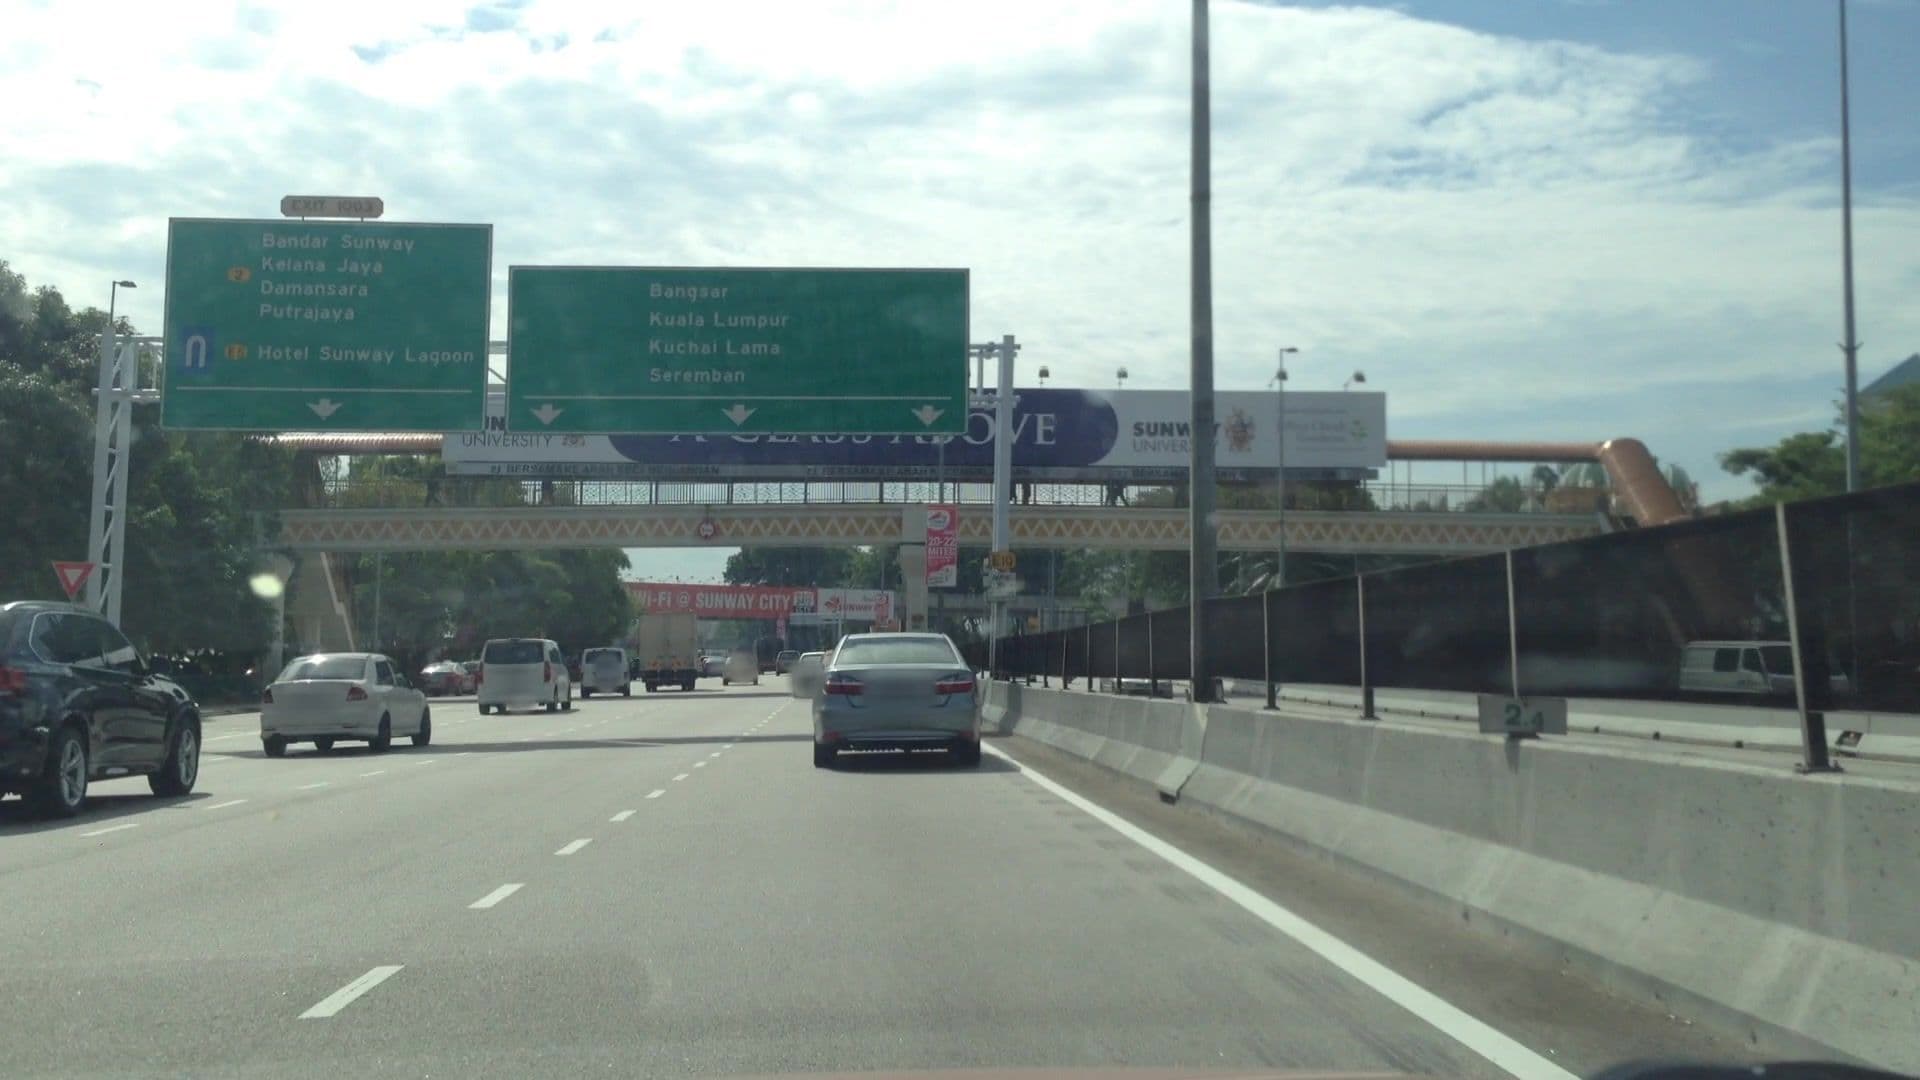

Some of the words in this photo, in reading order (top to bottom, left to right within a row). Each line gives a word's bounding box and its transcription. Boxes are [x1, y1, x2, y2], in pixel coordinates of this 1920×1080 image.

[291, 198, 326, 210] EXIT
[262, 233, 328, 249] Bandar
[340, 234, 416, 255] Sunway
[261, 256, 326, 272] Kelana
[337, 258, 384, 276] Jaya
[260, 279, 369, 297] Damansara
[649, 283, 729, 303] Bangsar
[259, 303, 356, 322] Putrajaya
[649, 312, 705, 327] Kuala
[713, 312, 790, 331] Lumpur
[257, 345, 309, 361] Hotel
[319, 346, 395, 365] Sunway
[405, 348, 475, 368] Lagoon
[648, 339, 718, 355] Kuchai
[726, 339, 781, 355] Lama
[649, 367, 746, 383] Seremban
[462, 434, 554, 448] UNIVERSITY
[679, 592, 689, 608] @
[695, 592, 754, 610] SUNWAY
[759, 594, 792, 612] CITY
